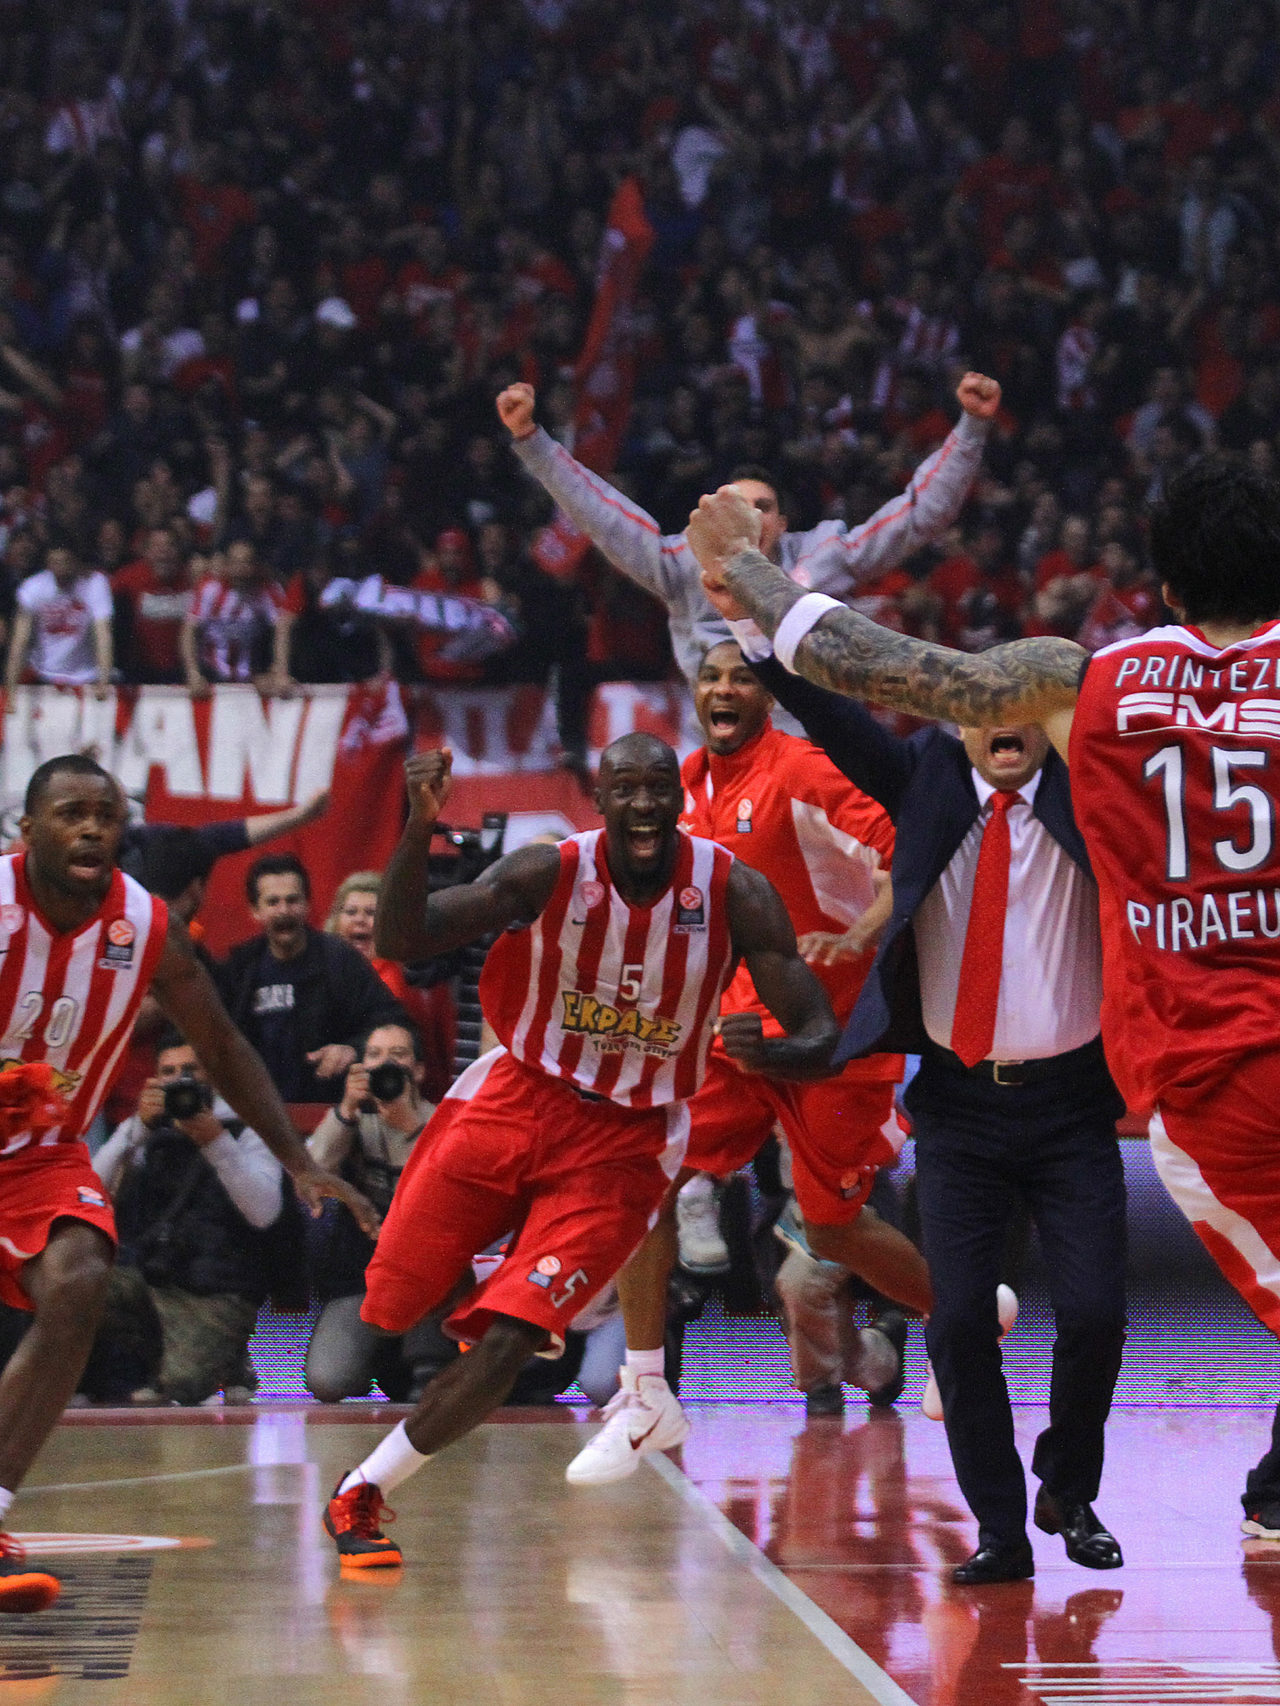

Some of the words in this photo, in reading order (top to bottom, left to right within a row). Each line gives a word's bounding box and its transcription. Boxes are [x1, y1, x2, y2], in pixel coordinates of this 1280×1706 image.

[1143, 745, 1274, 883] 15
[619, 962, 644, 1003] 5
[14, 990, 78, 1049] 20
[550, 1267, 590, 1309] 5
